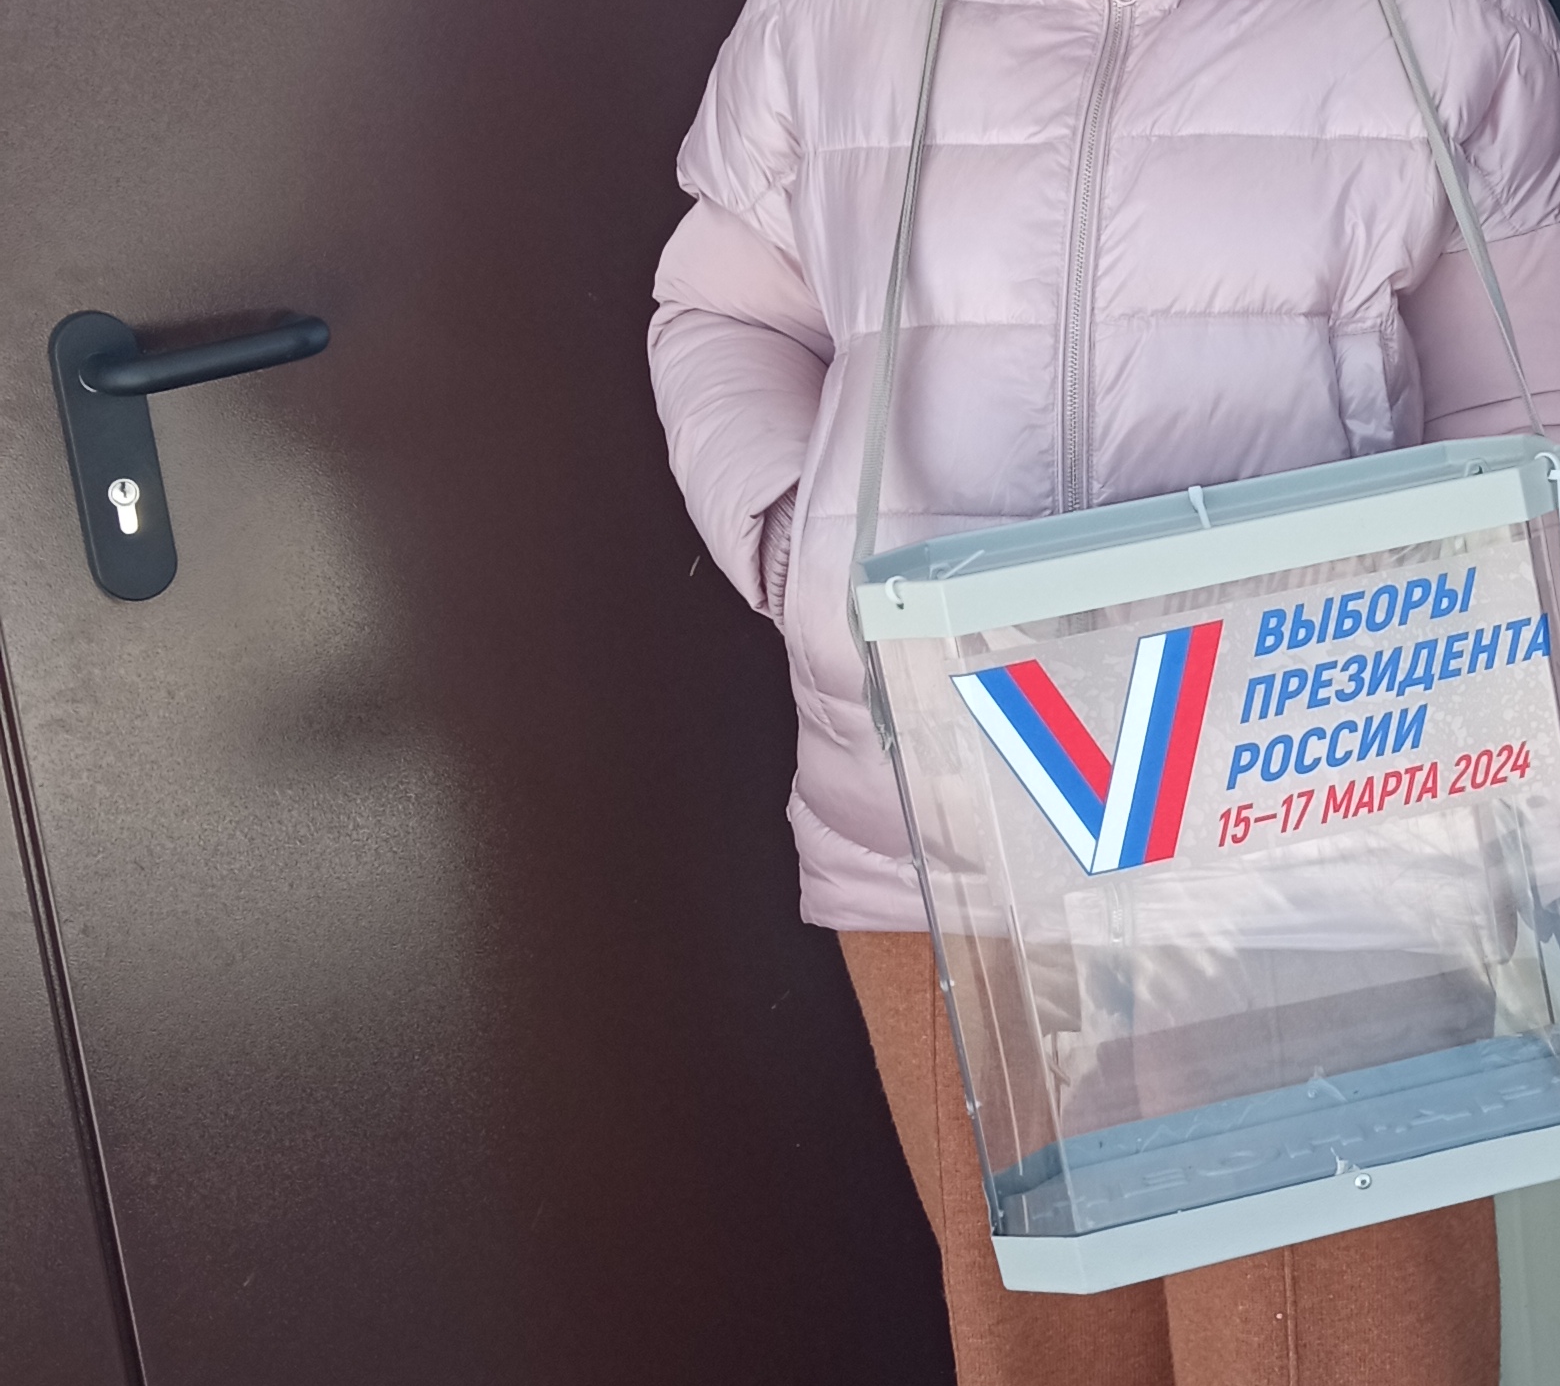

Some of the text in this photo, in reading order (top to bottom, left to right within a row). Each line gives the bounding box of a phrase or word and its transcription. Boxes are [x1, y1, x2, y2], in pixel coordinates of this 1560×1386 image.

[1254, 566, 1477, 658] ВЫБОРЫ
[1240, 612, 1551, 724] ПРЕЗИДЕНТА
[1226, 703, 1428, 791] РОССИИ
[1320, 761, 1439, 824] МАРТА
[1448, 740, 1531, 796] 2024
